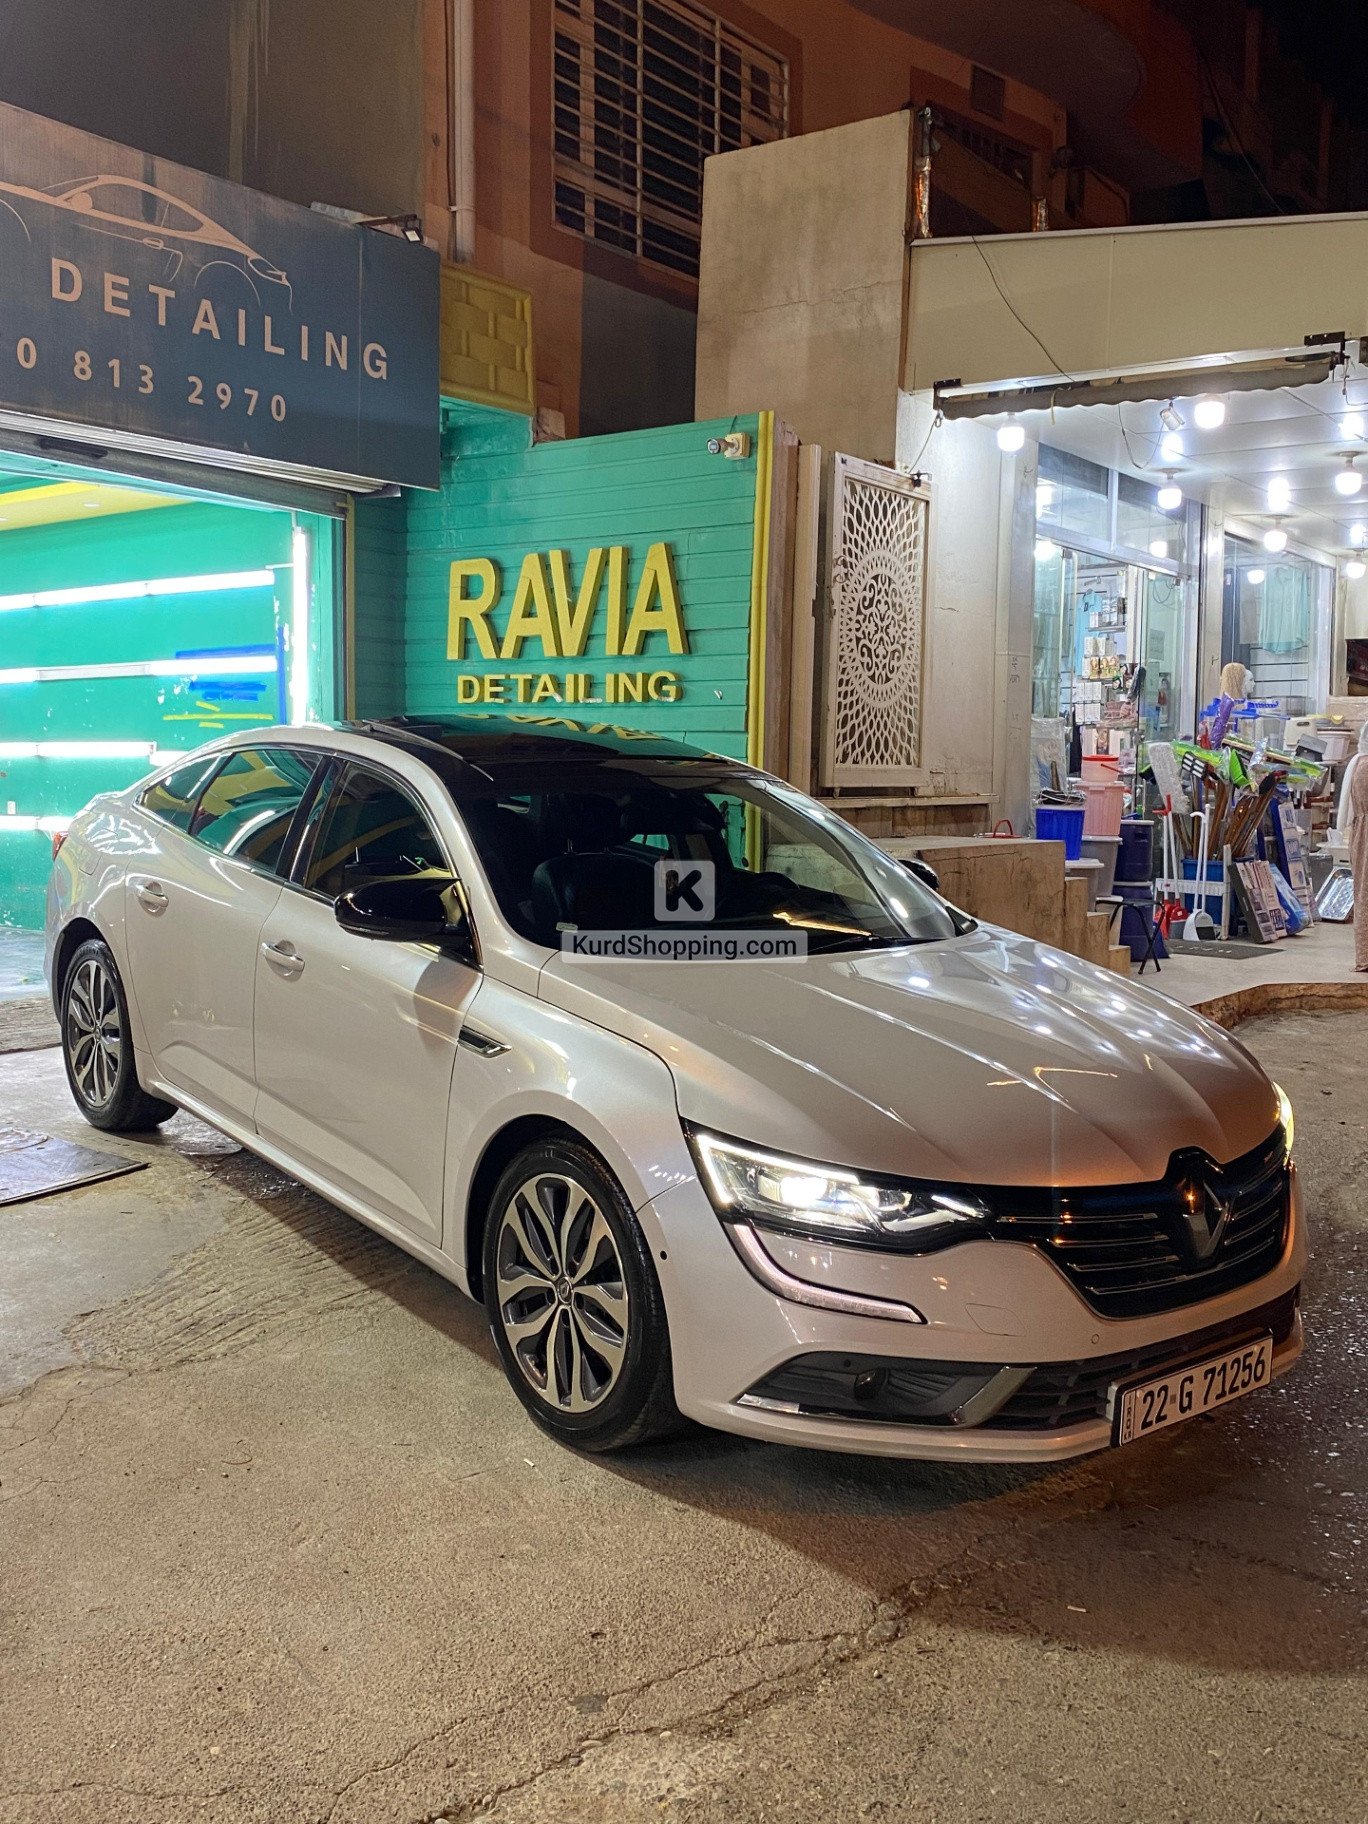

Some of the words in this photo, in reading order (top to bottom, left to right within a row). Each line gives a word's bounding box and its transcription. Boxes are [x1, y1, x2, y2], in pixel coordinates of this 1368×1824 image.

[51, 257, 388, 380] DETAILING
[73, 351, 154, 394] 813
[187, 376, 287, 422] 2970
[446, 542, 691, 660] RAVIA
[457, 671, 684, 704] DETAILING
[1141, 1384, 1169, 1430] 22
[1178, 1375, 1194, 1414] G
[1203, 1346, 1266, 1406] 71256
